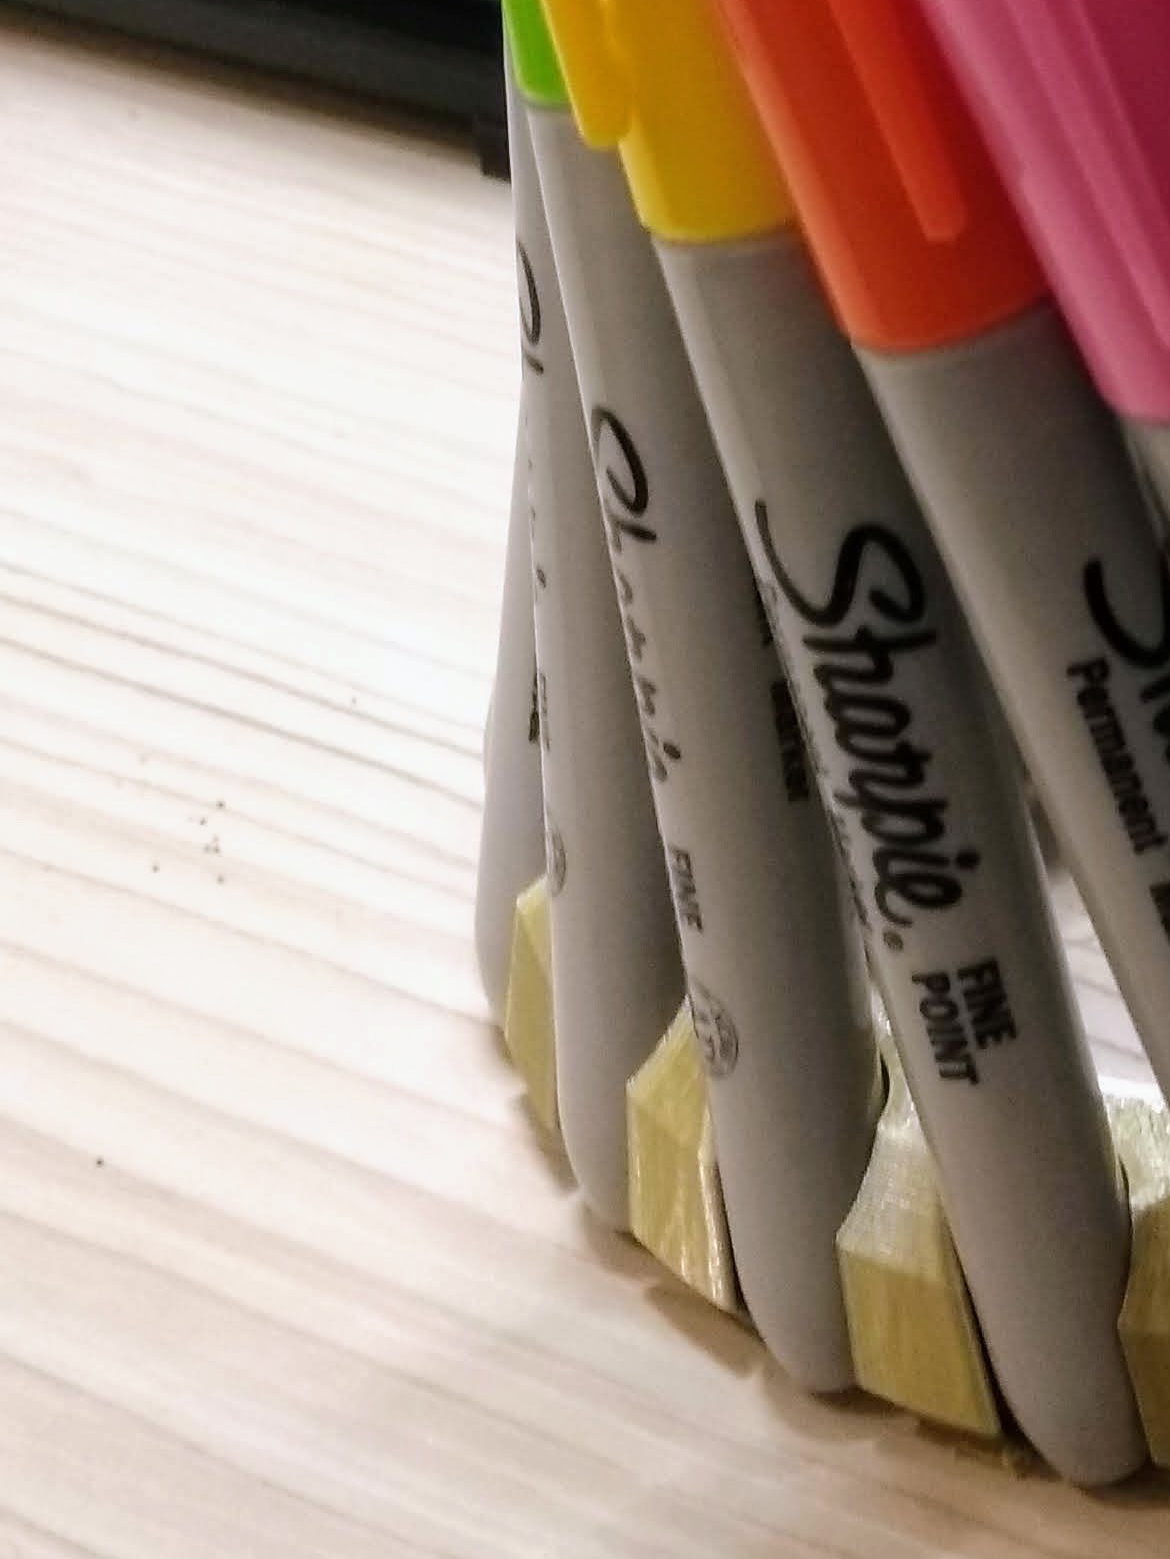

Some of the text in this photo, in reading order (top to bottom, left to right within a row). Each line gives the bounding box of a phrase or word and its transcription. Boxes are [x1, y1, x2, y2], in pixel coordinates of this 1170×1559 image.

[1066, 657, 1169, 854] Permanent
[912, 969, 981, 1087] POINT
[957, 955, 1018, 1051] FINE
